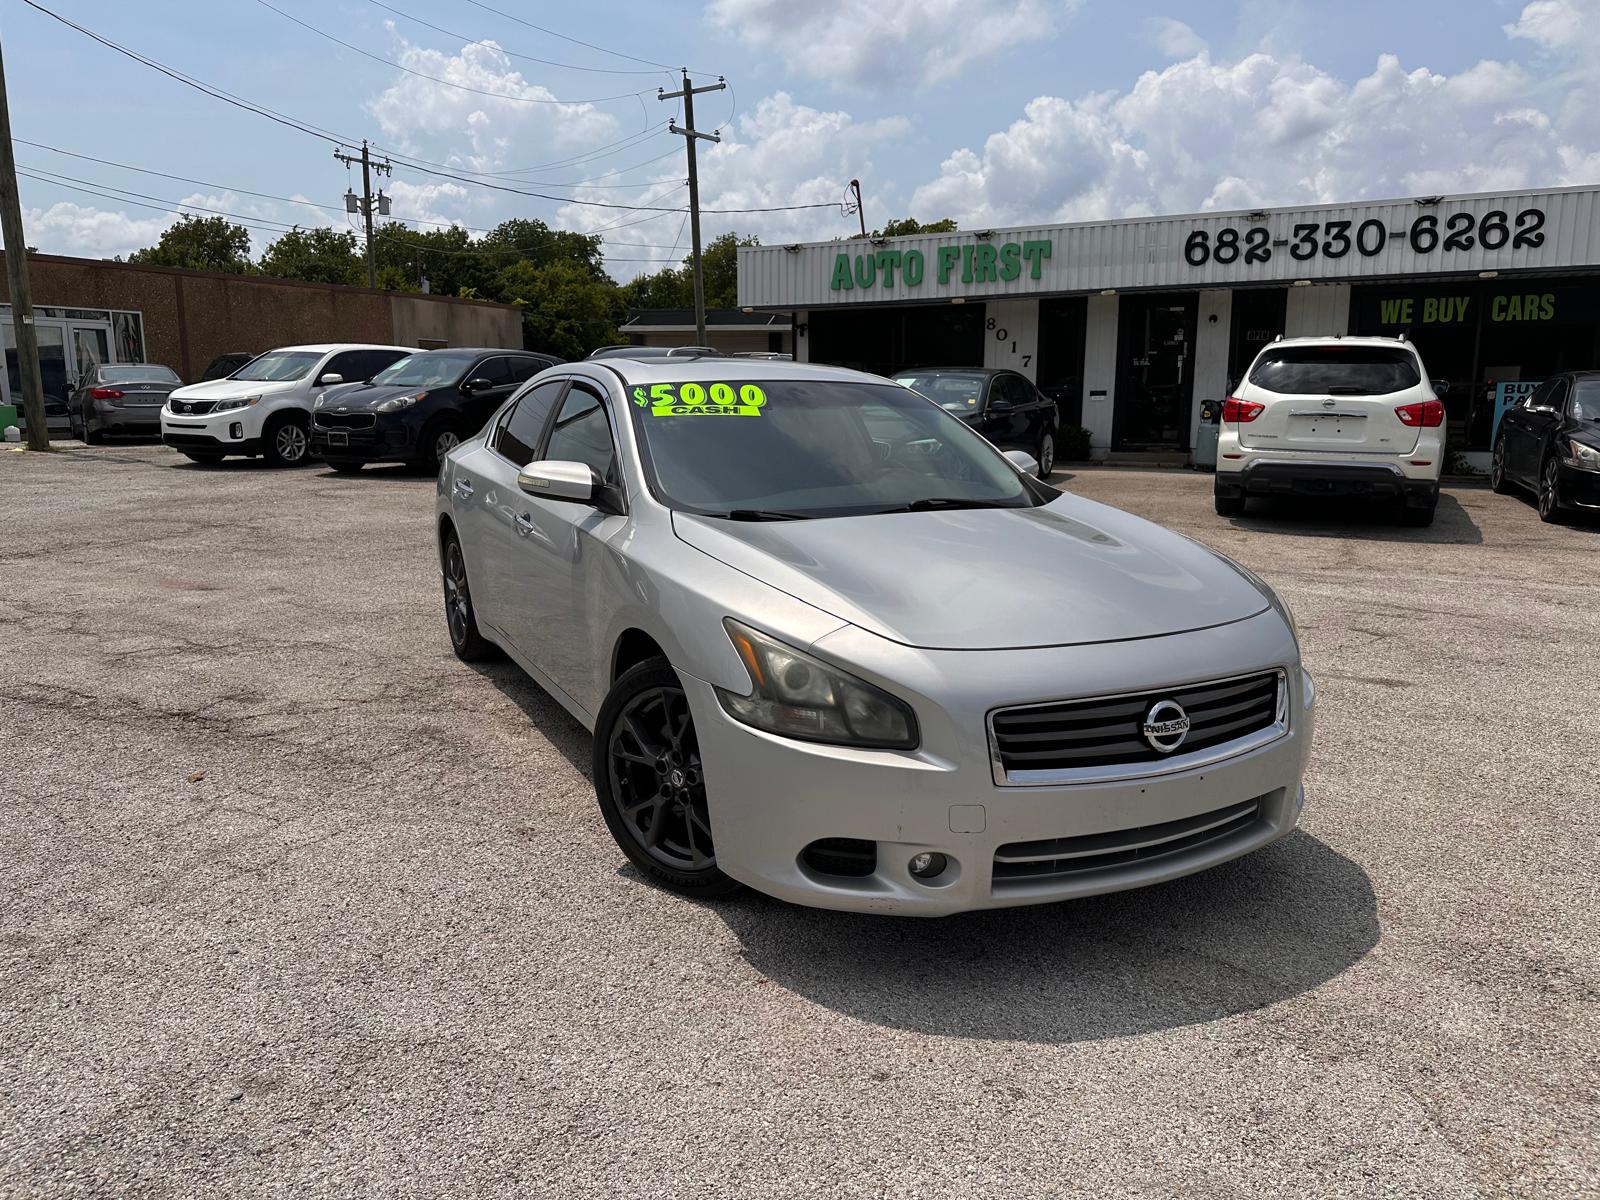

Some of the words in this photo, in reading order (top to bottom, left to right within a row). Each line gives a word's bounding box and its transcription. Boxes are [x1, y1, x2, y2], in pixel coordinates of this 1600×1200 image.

[1184, 208, 1546, 266] 682-330-6262
[831, 248, 924, 290] AUTO
[937, 240, 1052, 284] FIRST
[1381, 299, 1413, 324] WE
[1423, 296, 1470, 322] BUY
[1492, 294, 1555, 321] CARS
[986, 317, 1032, 368] 8017
[633, 383, 767, 407] $5000
[1503, 395, 1526, 406] PA
[671, 406, 741, 415] CASH
[1149, 719, 1189, 734] NISSAN
